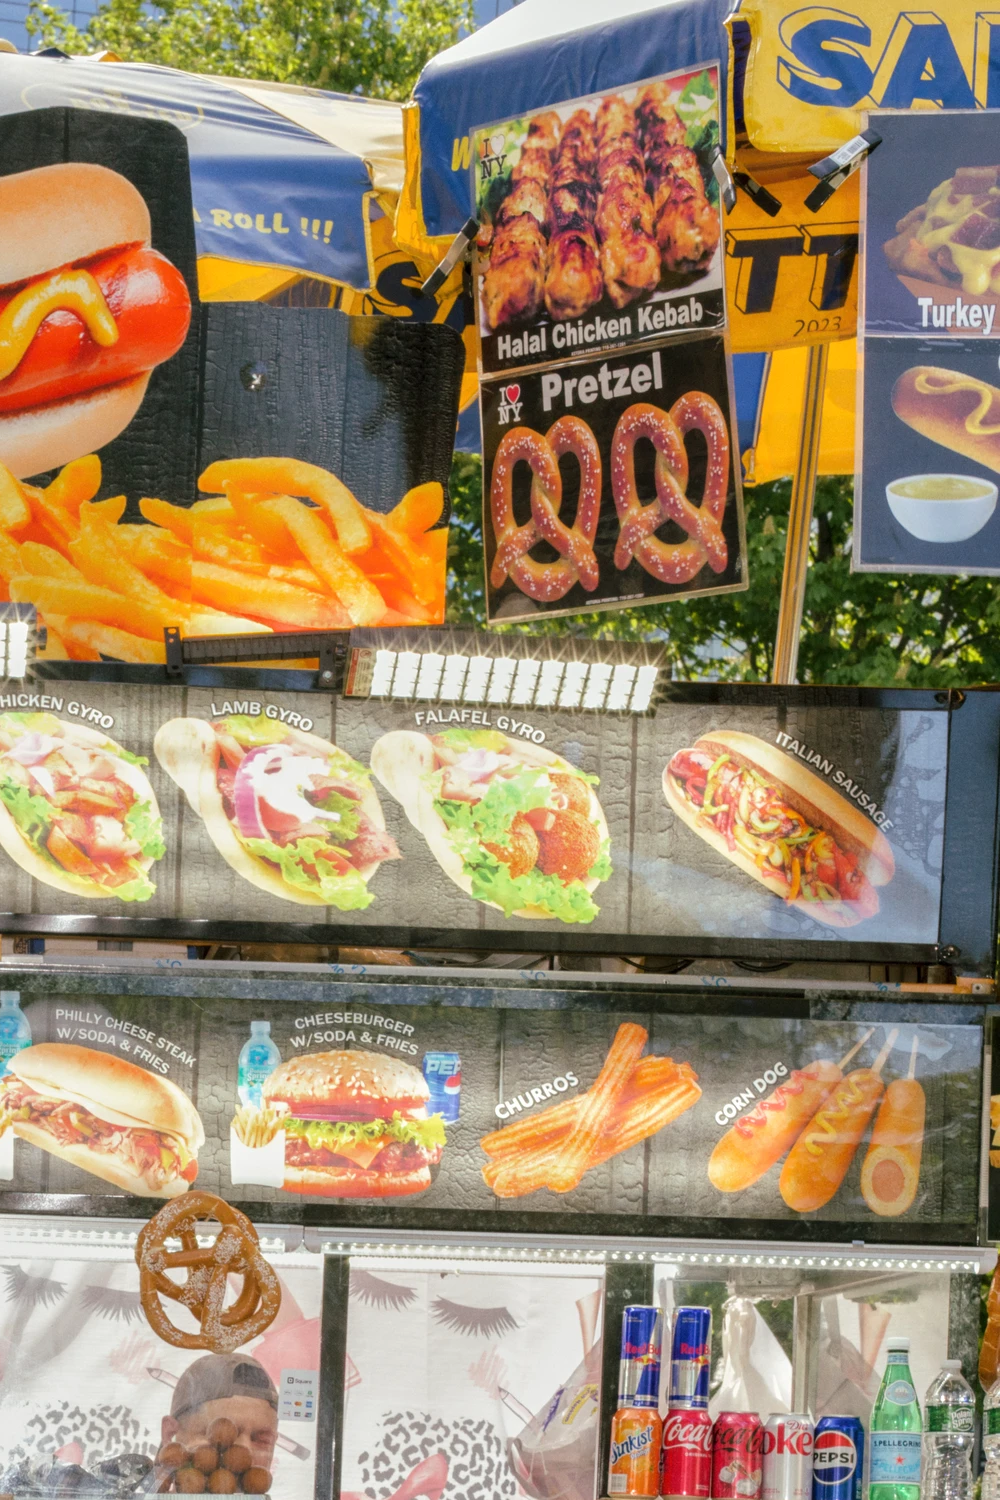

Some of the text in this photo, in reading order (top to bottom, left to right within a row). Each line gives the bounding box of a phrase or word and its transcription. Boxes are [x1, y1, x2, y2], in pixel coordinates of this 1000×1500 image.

[213, 208, 290, 236] ROLL
[497, 325, 547, 361] Halal
[551, 309, 632, 352] Chicken
[637, 298, 704, 330] Kebab
[917, 297, 996, 336] Turkey
[541, 352, 663, 413] Pretzel
[66, 700, 115, 731] GYRO
[210, 702, 314, 733] LAMB GYRO
[413, 709, 547, 746] FALAFEL GYRO
[774, 730, 895, 834] ITALIAN SAUSAGE
[55, 1007, 198, 1068] PHILLY CHEESE STEAK
[294, 1011, 416, 1038] CHEESEBURGER
[132, 1044, 171, 1075] FRIES
[376, 1033, 420, 1057] FRIES
[494, 1070, 580, 1121] CHURROS
[714, 1060, 790, 1128] CORN DOG
[610, 1426, 653, 1465] Sunkist
[812, 1452, 855, 1464] PEPSI
